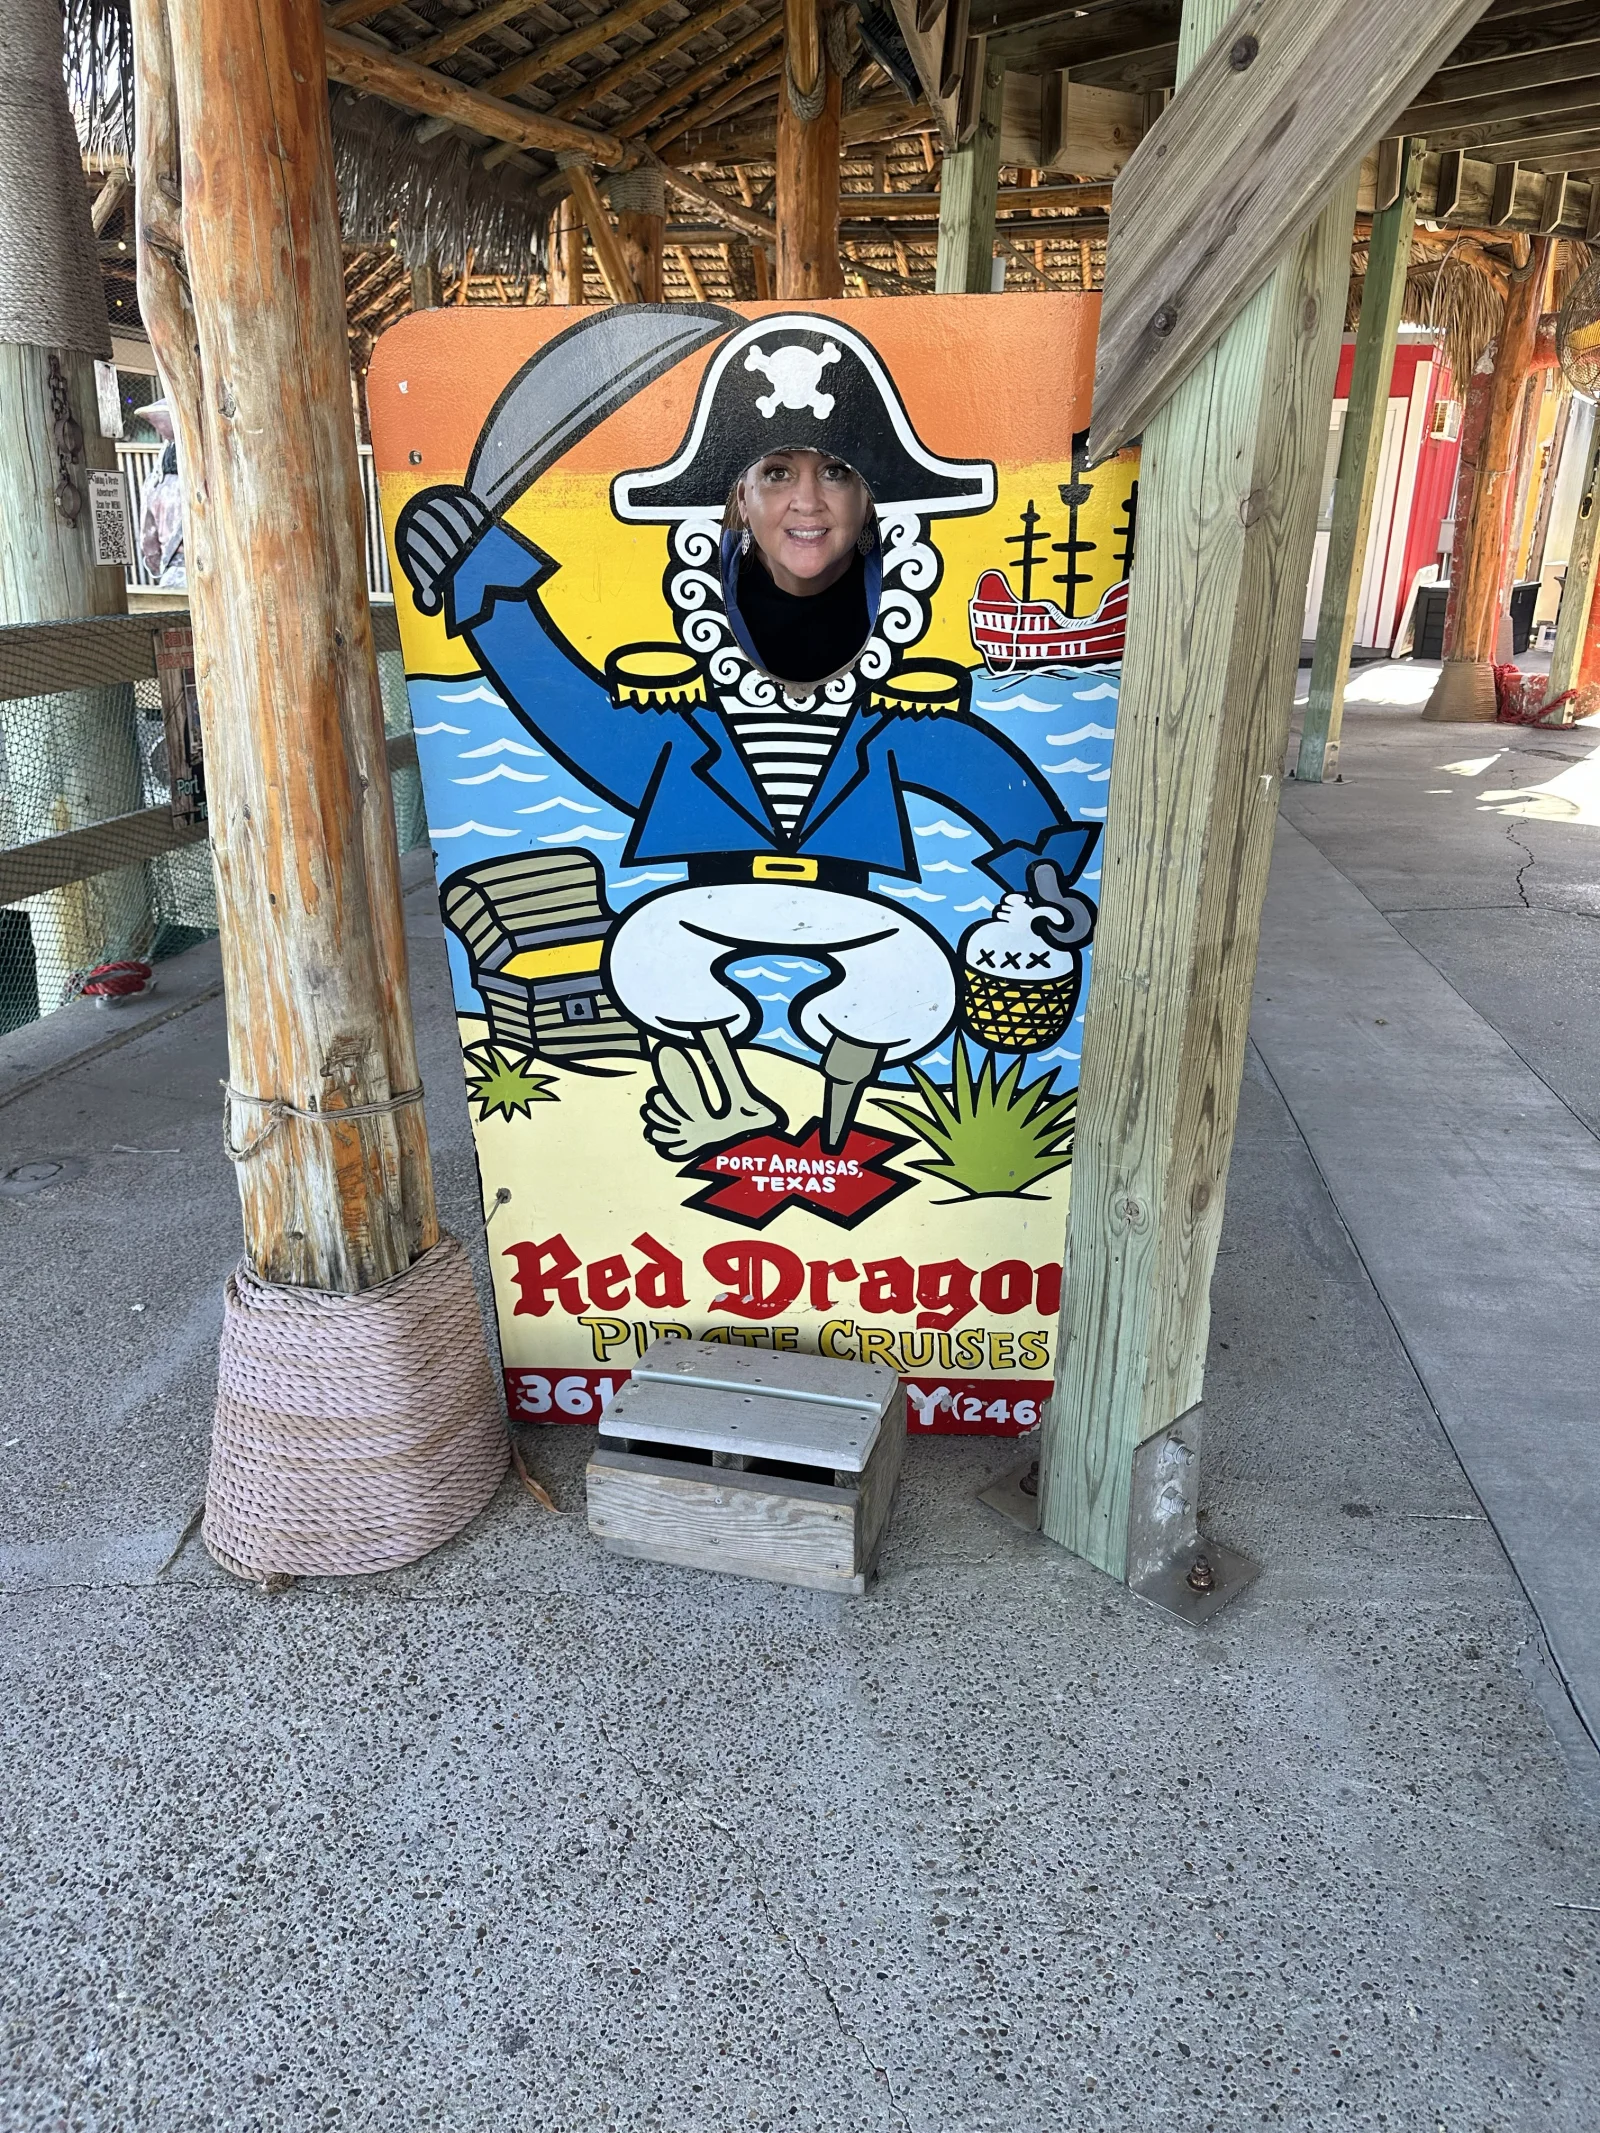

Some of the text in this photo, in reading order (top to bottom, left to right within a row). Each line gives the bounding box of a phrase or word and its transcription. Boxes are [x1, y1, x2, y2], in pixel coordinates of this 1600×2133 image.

[177, 774, 200, 797] Port
[716, 1153, 864, 1179] PORT ARANSAS,
[751, 1175, 837, 1193] TEXAS
[501, 1231, 692, 1318] Red
[818, 1319, 1050, 1374] CRUISES
